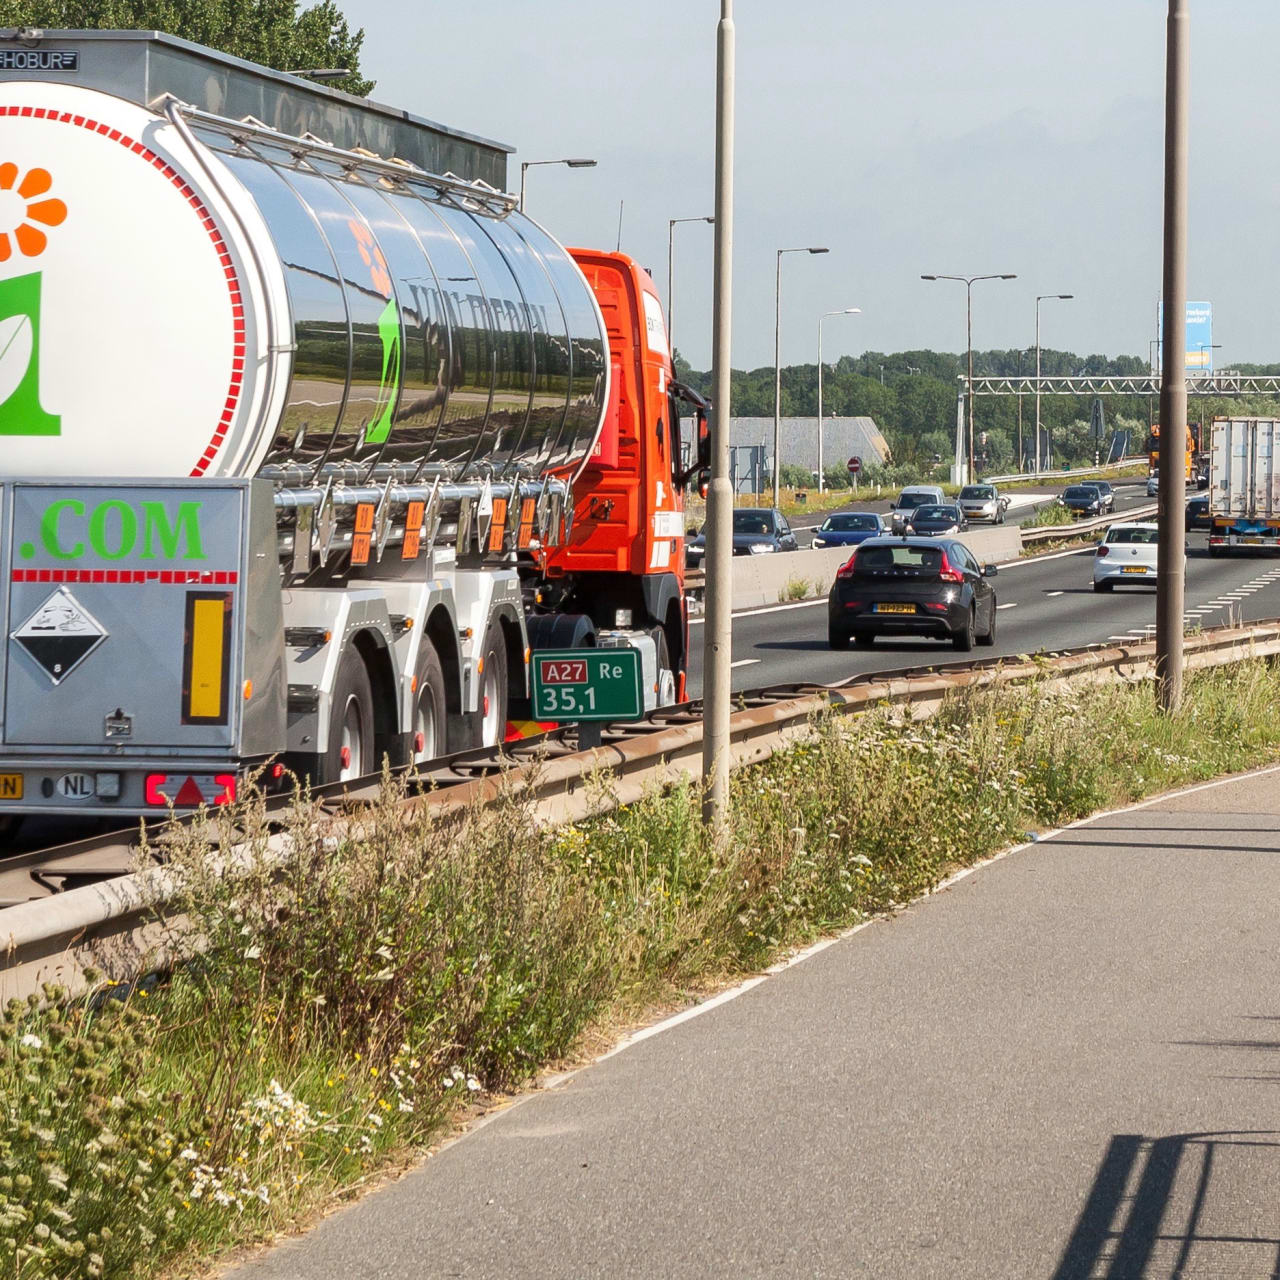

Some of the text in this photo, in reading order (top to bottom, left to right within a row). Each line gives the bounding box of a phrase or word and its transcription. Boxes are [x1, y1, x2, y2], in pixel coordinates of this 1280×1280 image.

[3, 52, 63, 69] HOBUR
[19, 498, 209, 560] .COM
[546, 662, 623, 681] A27 Re
[542, 686, 597, 714] 35,1
[63, 775, 91, 797] NL
